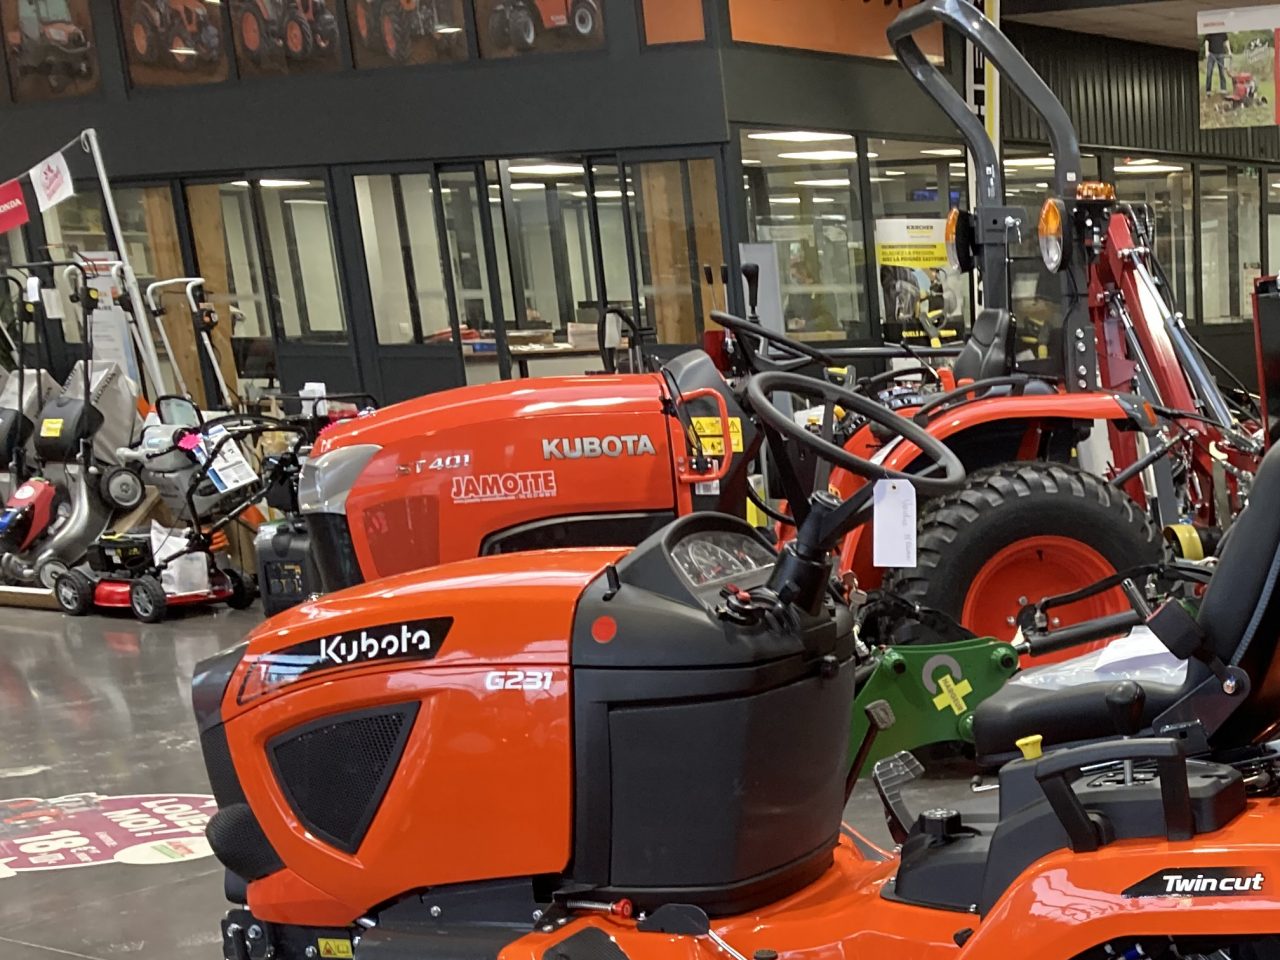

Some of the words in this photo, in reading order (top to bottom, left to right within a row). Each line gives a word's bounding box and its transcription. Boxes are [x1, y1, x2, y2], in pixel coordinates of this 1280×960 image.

[0, 198, 22, 213] ONDA
[541, 434, 656, 460] KUBOTA
[451, 470, 557, 499] JAMOTTE
[320, 625, 430, 663] Kubota
[485, 670, 552, 690] G231
[13, 829, 90, 854] 18
